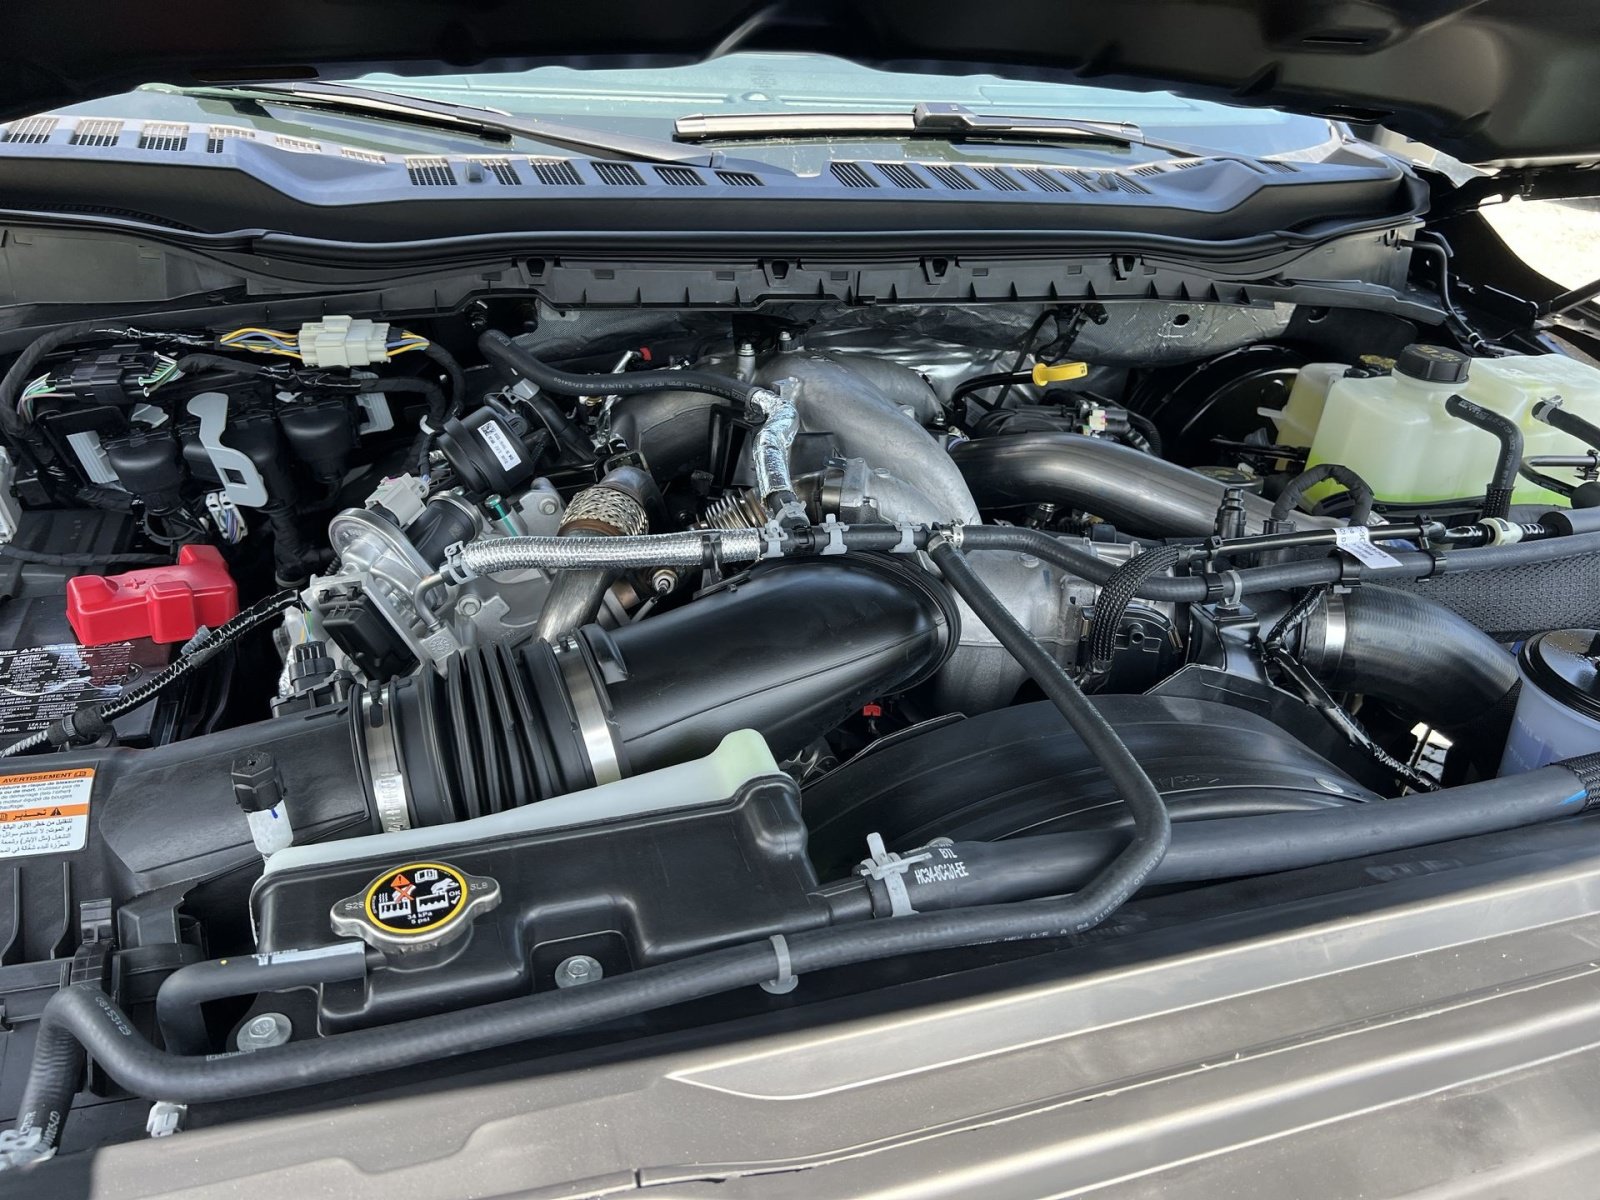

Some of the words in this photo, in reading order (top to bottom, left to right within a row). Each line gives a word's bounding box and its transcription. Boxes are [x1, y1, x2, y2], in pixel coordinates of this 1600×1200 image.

[3, 772, 71, 783] AVERTISSEMENT
[938, 848, 958, 859] BTL
[449, 889, 461, 897] OK
[418, 916, 430, 924] psi
